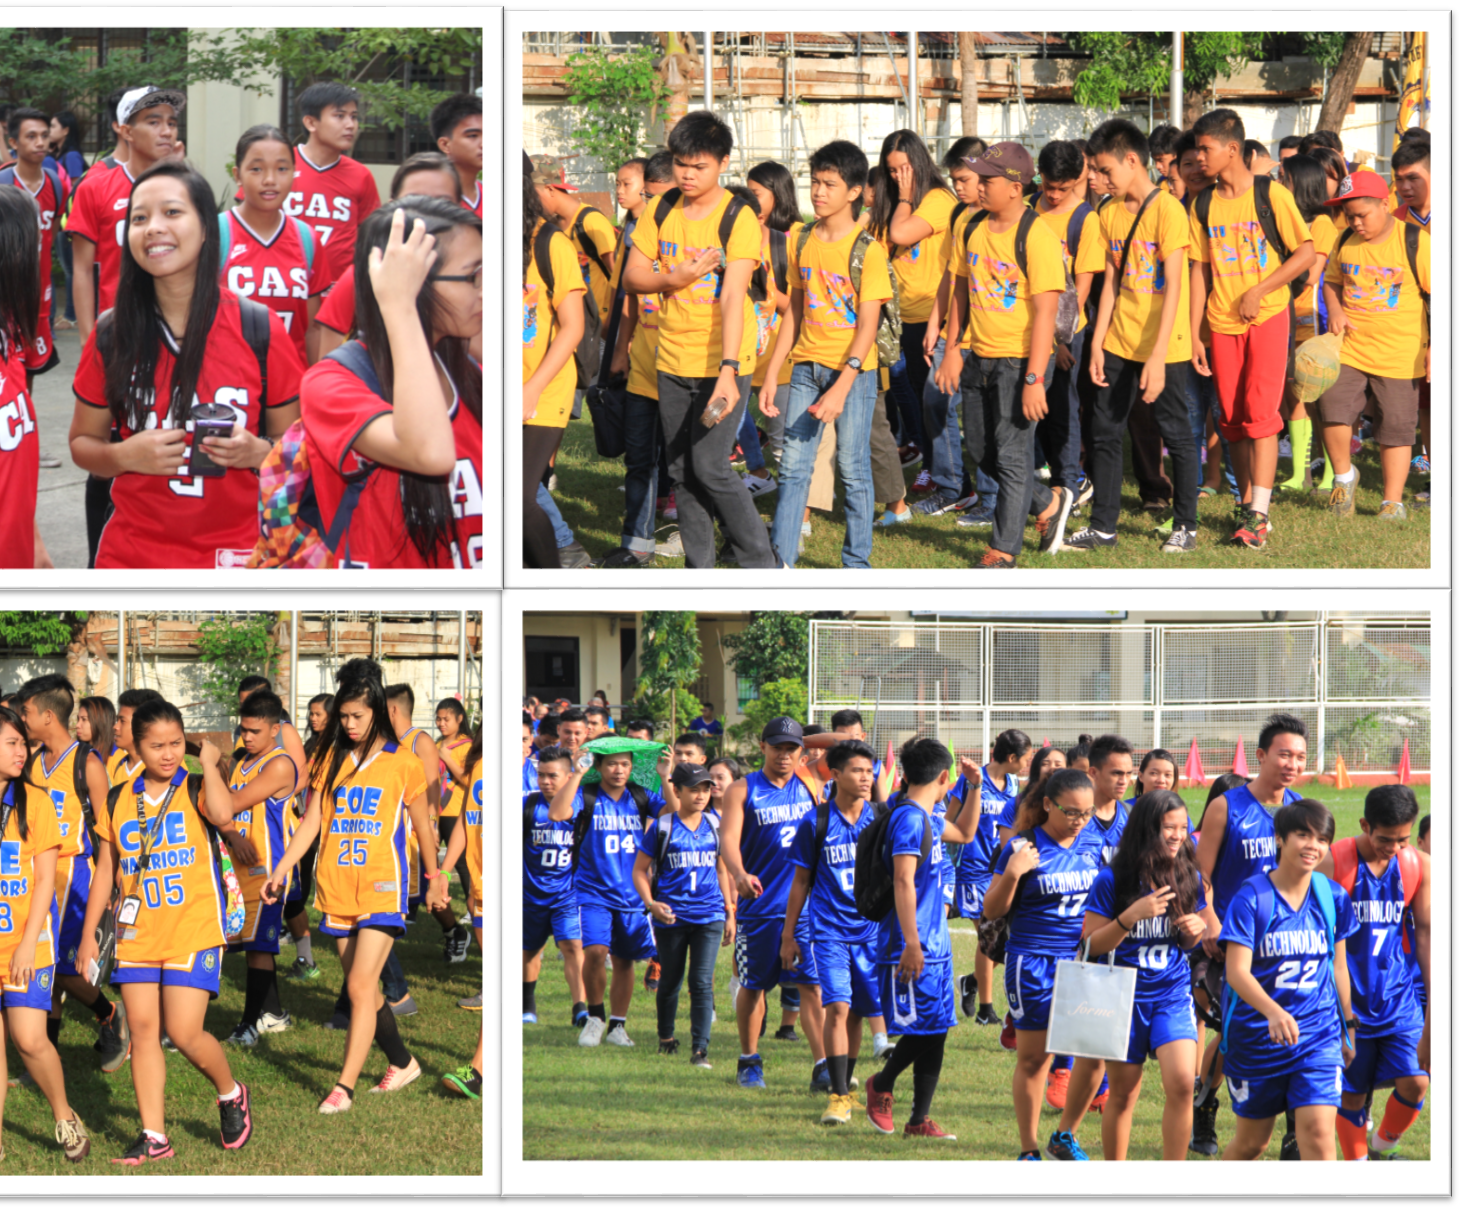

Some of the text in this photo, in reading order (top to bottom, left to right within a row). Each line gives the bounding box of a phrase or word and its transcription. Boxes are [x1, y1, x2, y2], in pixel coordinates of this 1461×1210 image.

[282, 191, 351, 223] CAS
[227, 265, 309, 300] CAS
[127, 386, 249, 432] CS
[334, 785, 383, 817] COE
[119, 811, 187, 852] COE
[605, 834, 636, 854] 04
[120, 846, 196, 877] WARIORS
[338, 839, 368, 867] 25
[541, 848, 573, 868] 08
[143, 873, 185, 910] 05
[689, 870, 698, 892] 1
[1058, 893, 1089, 918] 17
[1137, 944, 1169, 969] 10
[1372, 928, 1389, 956] 7
[1275, 960, 1320, 989] 22
